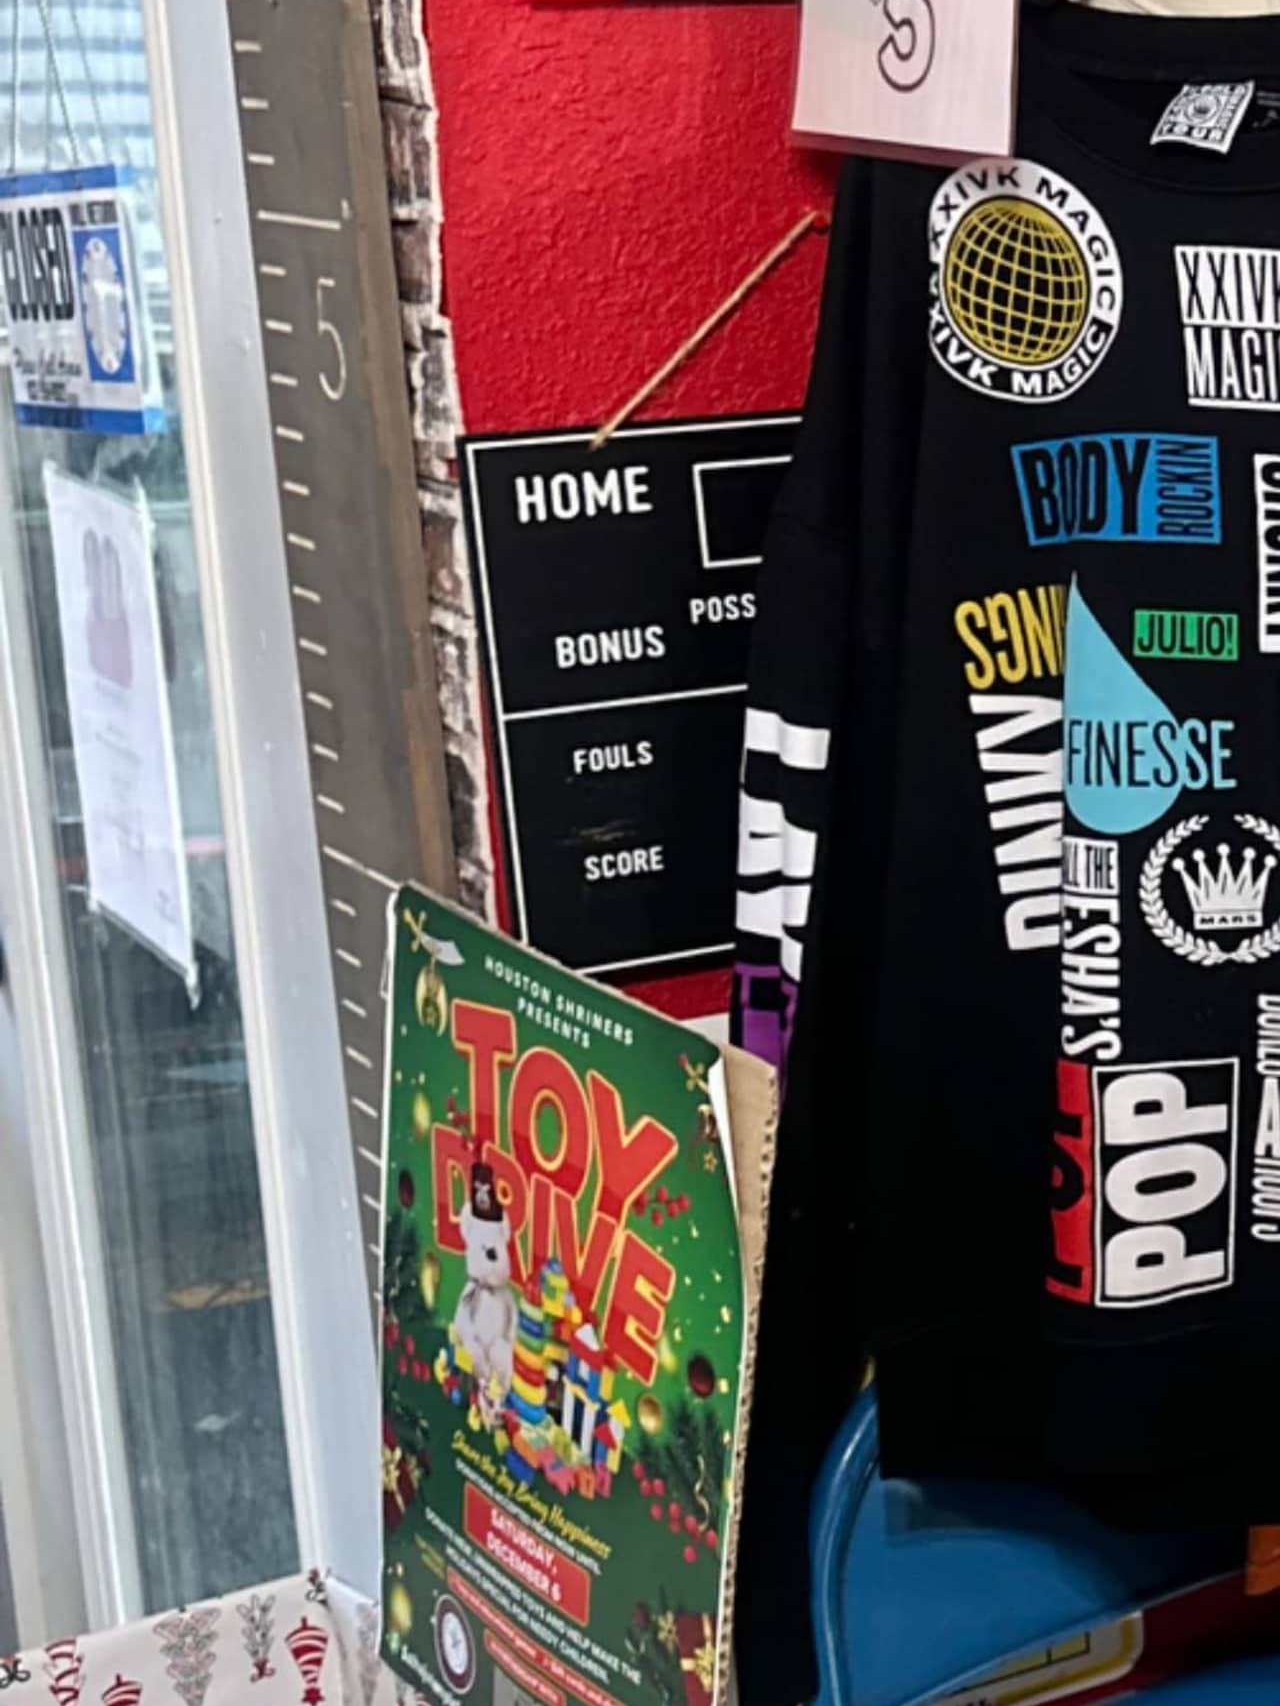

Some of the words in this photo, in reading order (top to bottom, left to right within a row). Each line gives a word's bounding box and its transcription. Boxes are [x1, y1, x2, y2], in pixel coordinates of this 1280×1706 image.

[1035, 175, 1117, 313] MAGIC
[314, 277, 349, 401] 5
[1009, 326, 1107, 396] MAGIC
[515, 466, 652, 524] HOME
[1016, 438, 1154, 542] BODY
[1156, 438, 1215, 539] ROCKIN
[689, 593, 757, 625] POSS
[1137, 612, 1237, 657] JULIO!
[555, 625, 665, 669] BONUS
[573, 740, 653, 774] FOULS
[1068, 718, 1238, 790] FINESSE
[584, 845, 664, 881] SCORE
[1199, 914, 1258, 927] MARS
[484, 955, 552, 1004] HOUSTON
[555, 994, 635, 1047] SHRINERS
[517, 997, 591, 1049] PRESENTS
[451, 997, 678, 1227] TOY
[1104, 1071, 1228, 1301] POP
[431, 1122, 677, 1387] DRIVE
[486, 1528, 550, 1596] DECEMBER
